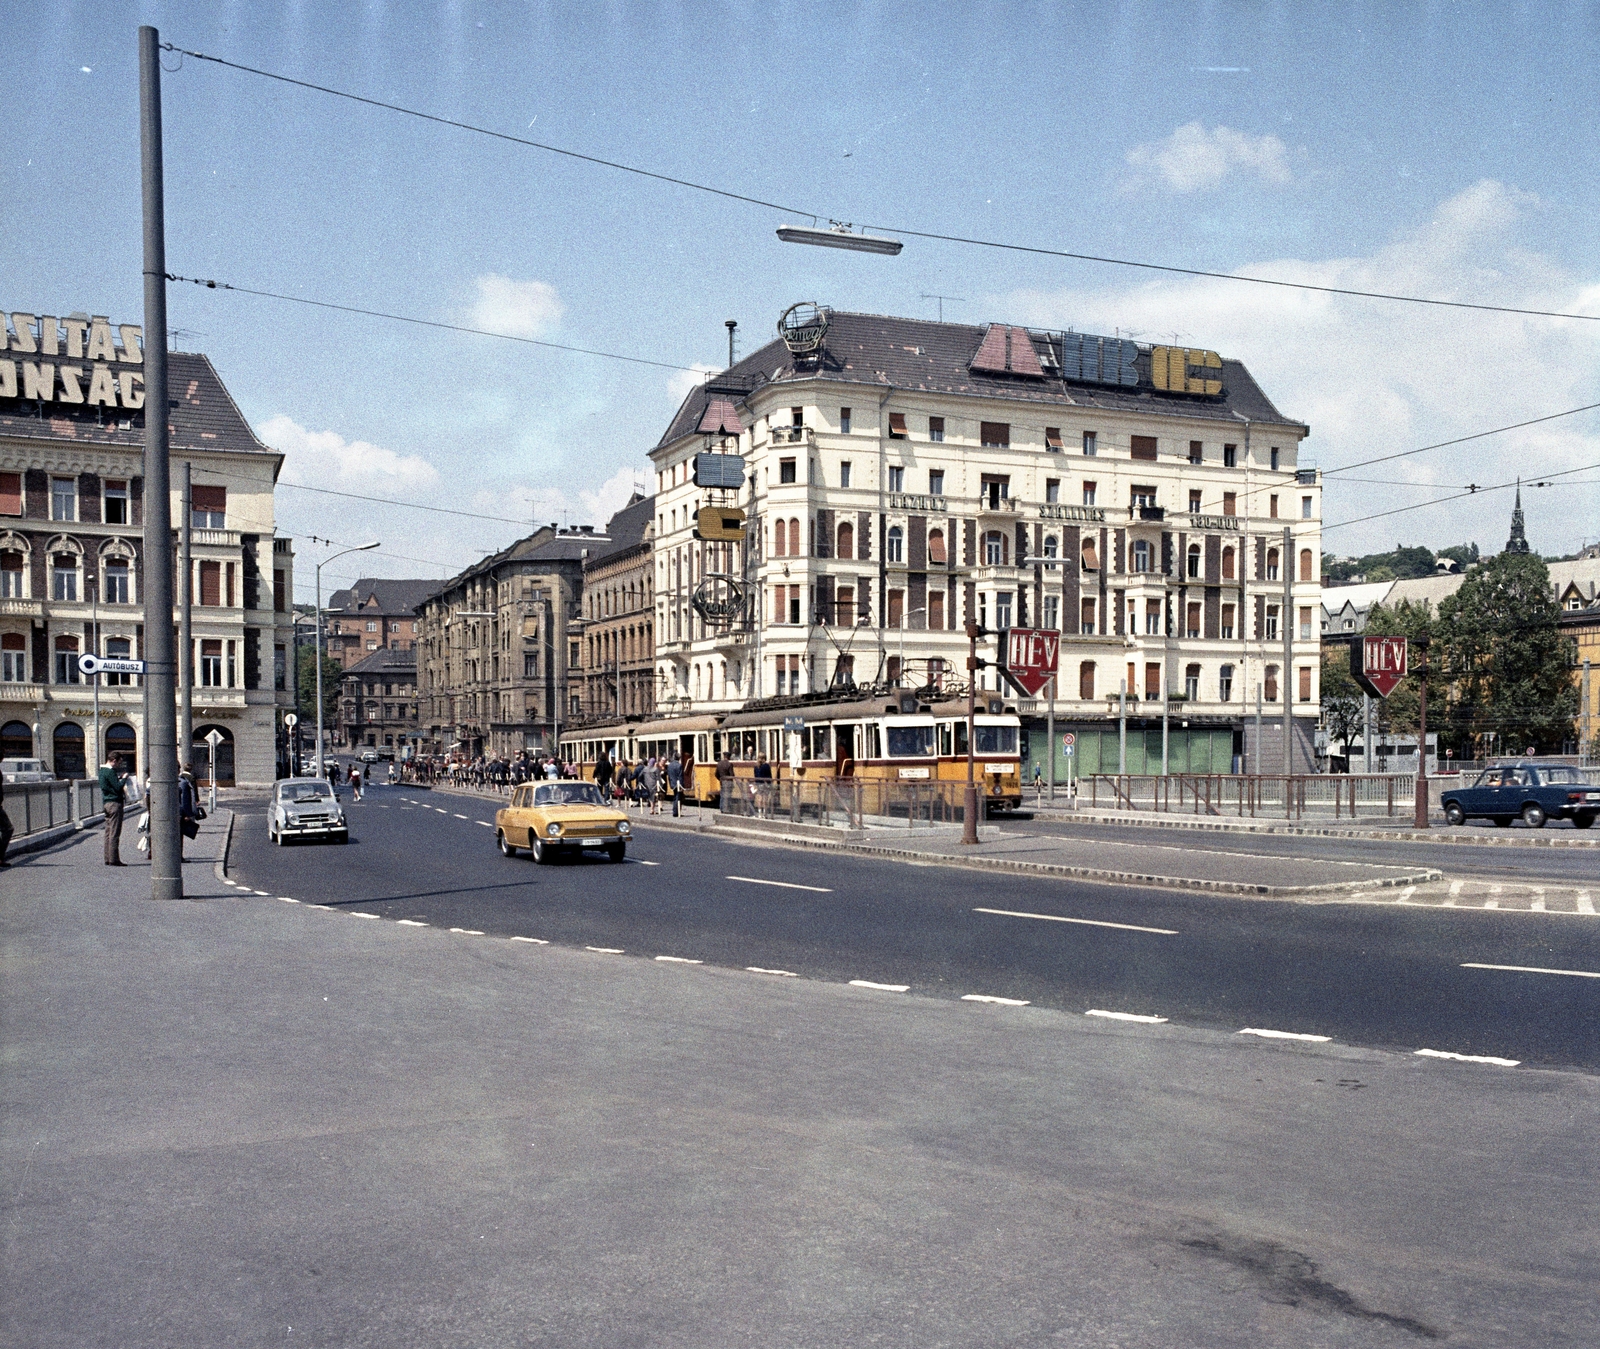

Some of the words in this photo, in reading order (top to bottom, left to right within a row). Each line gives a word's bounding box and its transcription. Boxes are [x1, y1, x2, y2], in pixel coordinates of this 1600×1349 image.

[0, 310, 143, 364] SITÁS
[966, 322, 1223, 397] ABC
[696, 400, 746, 540] ABC
[102, 662, 140, 671] AUTÓBUSZ
[1010, 631, 1059, 668] HÉV
[1365, 638, 1406, 671] HÉV
[991, 703, 997, 713] 4
